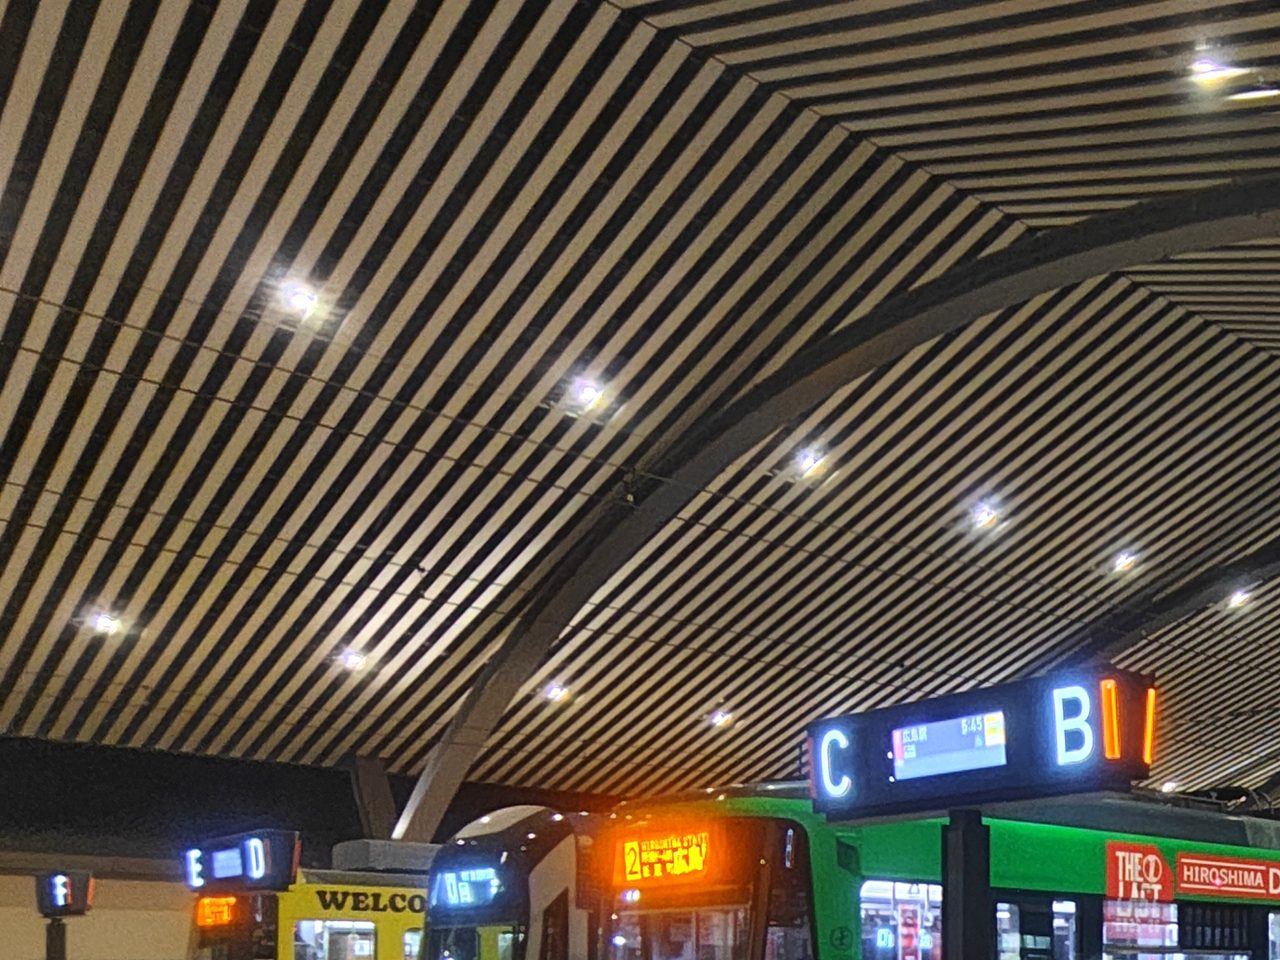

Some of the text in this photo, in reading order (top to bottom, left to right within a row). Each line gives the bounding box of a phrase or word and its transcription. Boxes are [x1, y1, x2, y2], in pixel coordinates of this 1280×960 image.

[1053, 686, 1093, 765] B
[821, 731, 849, 794] C
[186, 849, 203, 887] E
[245, 838, 264, 879] D
[1115, 851, 1143, 882] THE
[1183, 865, 1264, 888] HIROSHIMA
[316, 889, 427, 913] WELCO
